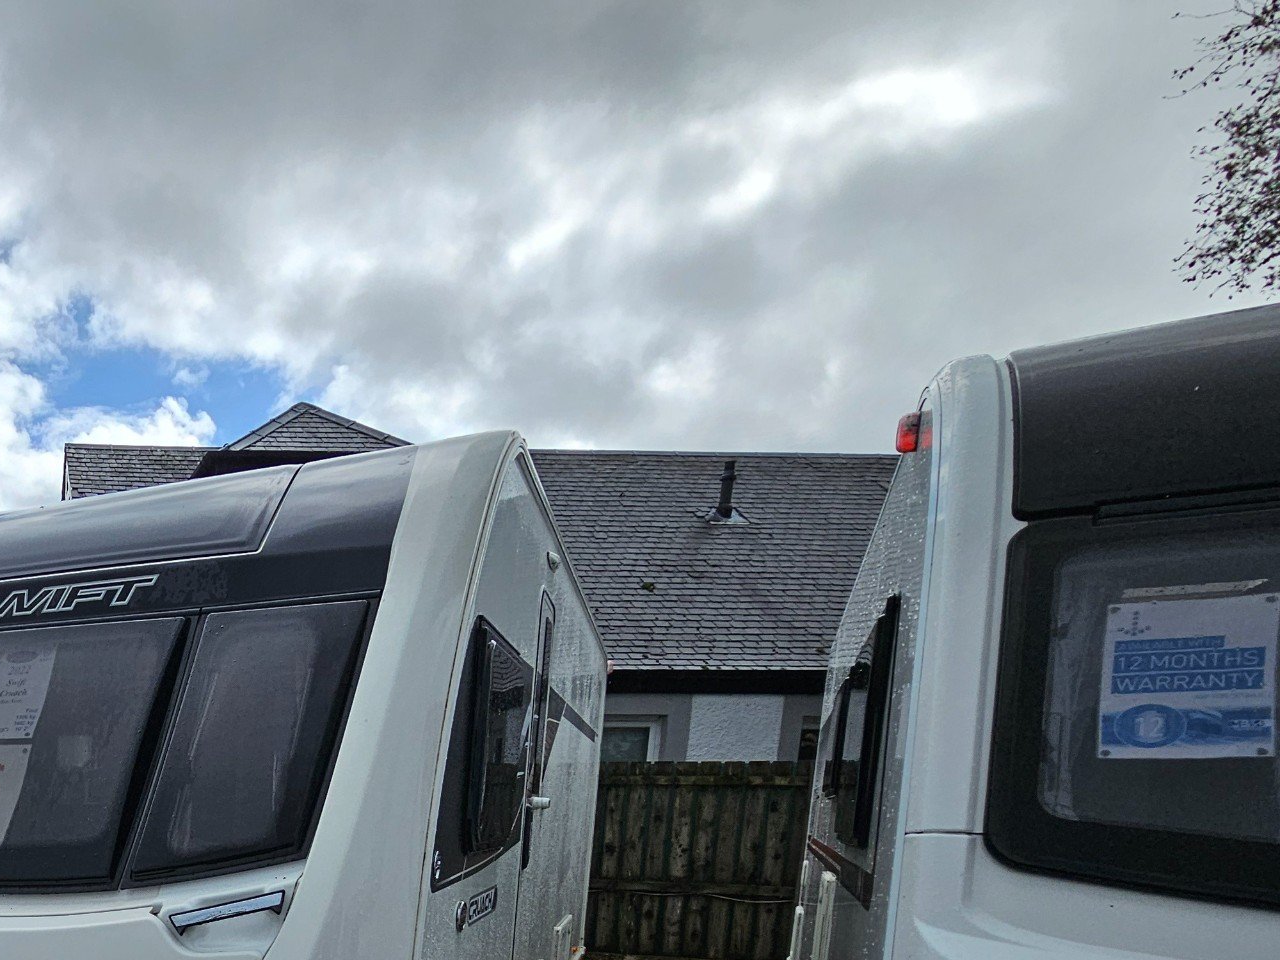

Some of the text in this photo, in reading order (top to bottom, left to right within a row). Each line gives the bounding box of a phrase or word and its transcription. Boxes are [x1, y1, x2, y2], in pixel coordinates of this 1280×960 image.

[1117, 650, 1259, 671] 12 MONTHS
[1135, 716, 1166, 738] 12
